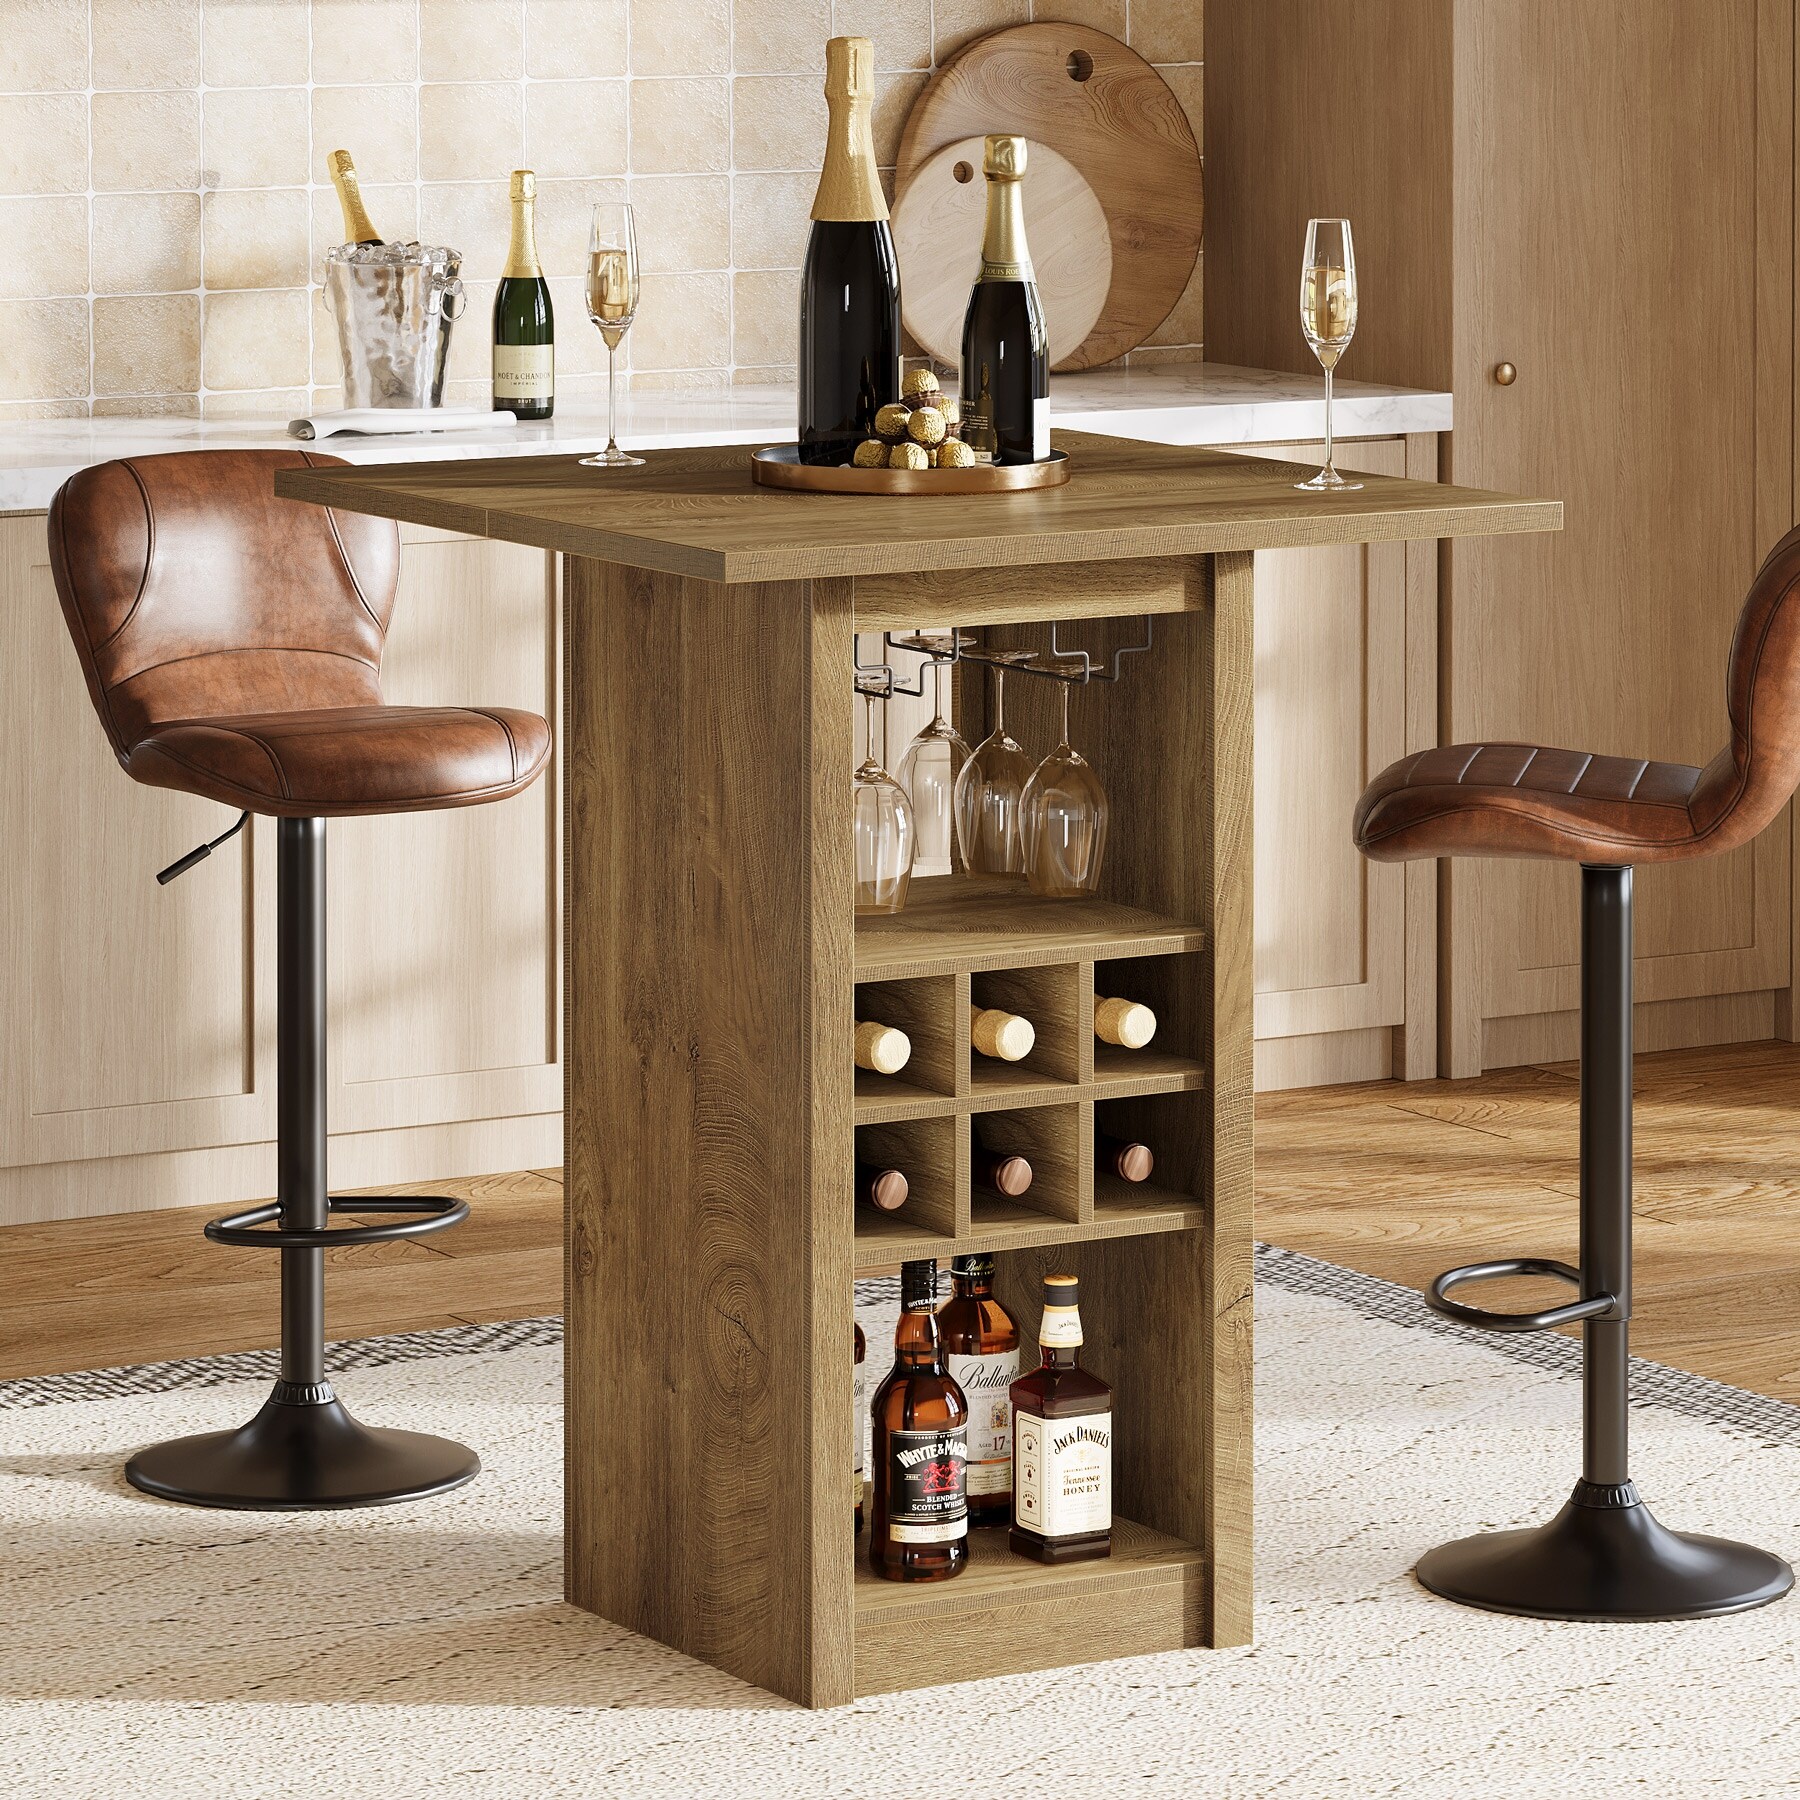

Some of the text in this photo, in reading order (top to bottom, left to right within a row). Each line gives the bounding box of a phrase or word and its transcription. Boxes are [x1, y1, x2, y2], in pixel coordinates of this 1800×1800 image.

[985, 267, 1004, 275] LOUIS
[993, 1435, 1006, 1451] 17
[1053, 1431, 1076, 1455] JACK
[1063, 1484, 1100, 1496] HONEY
[926, 1493, 958, 1503] BLENDED
[911, 1503, 942, 1511] SCOTCH
